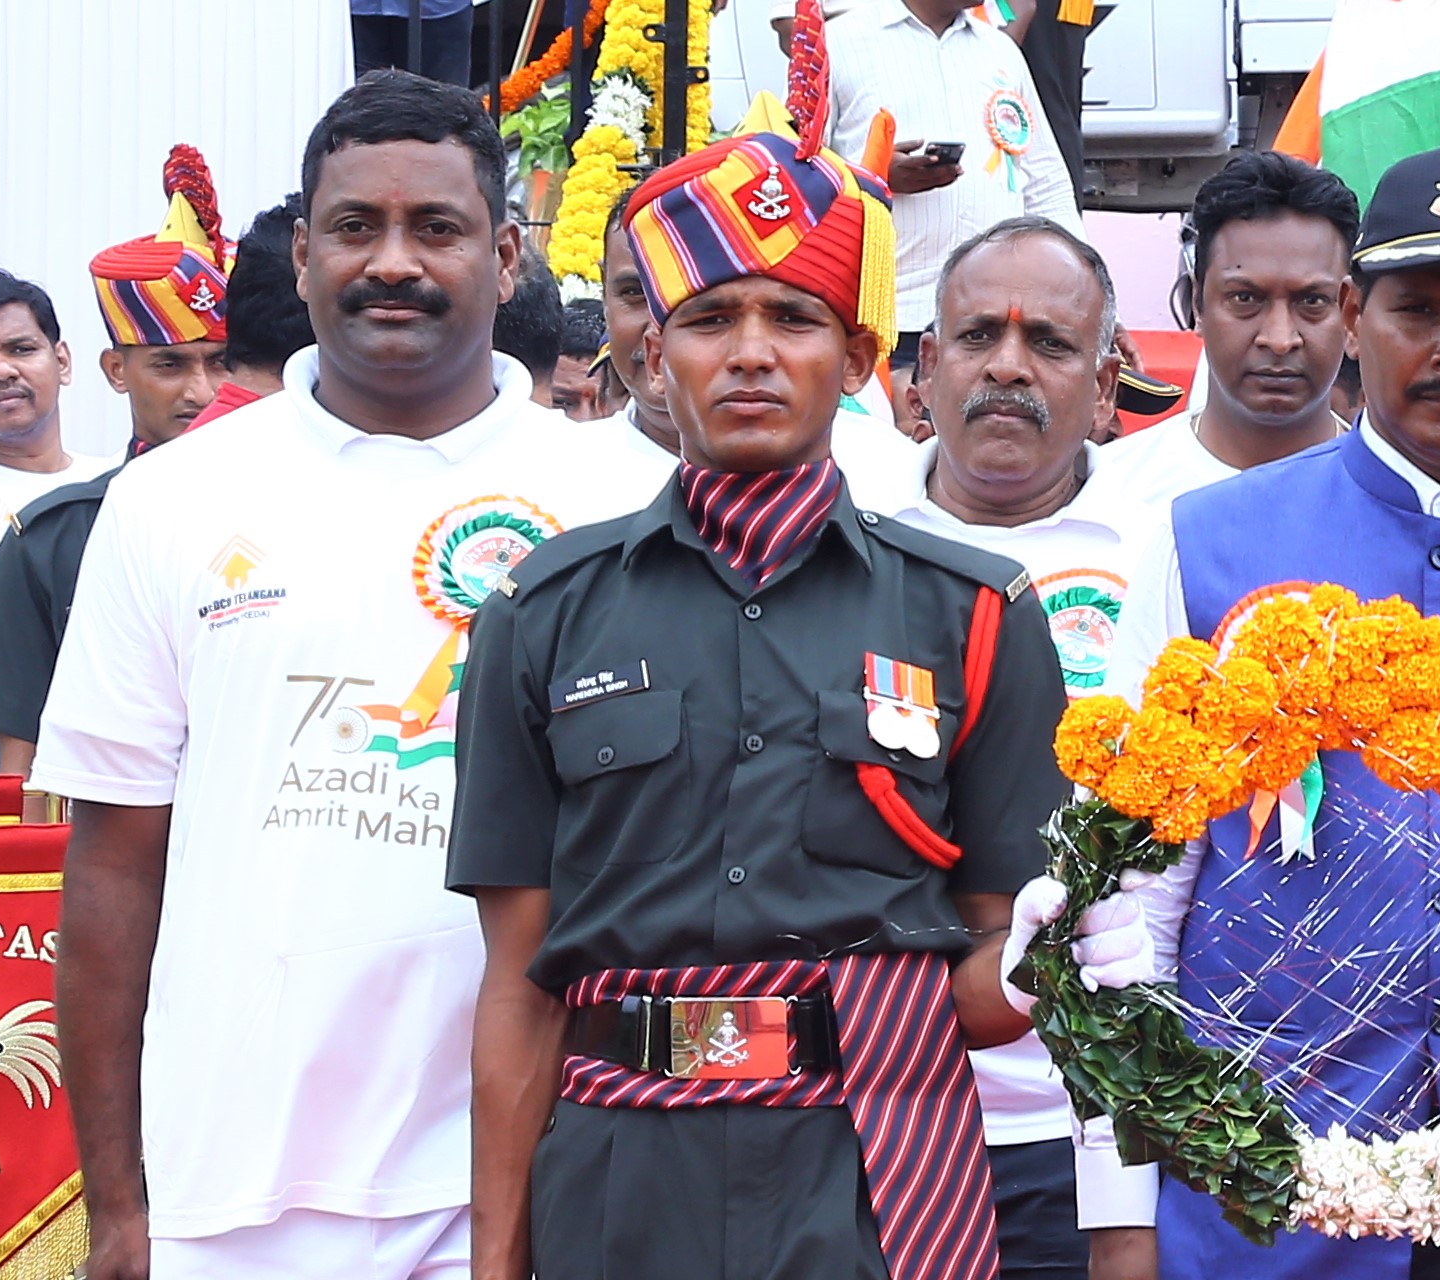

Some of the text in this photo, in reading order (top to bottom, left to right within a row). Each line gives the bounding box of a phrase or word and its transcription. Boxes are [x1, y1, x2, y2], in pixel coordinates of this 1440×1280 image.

[277, 761, 441, 812] Azadi Ka
[261, 799, 447, 849] Amrit Mah
